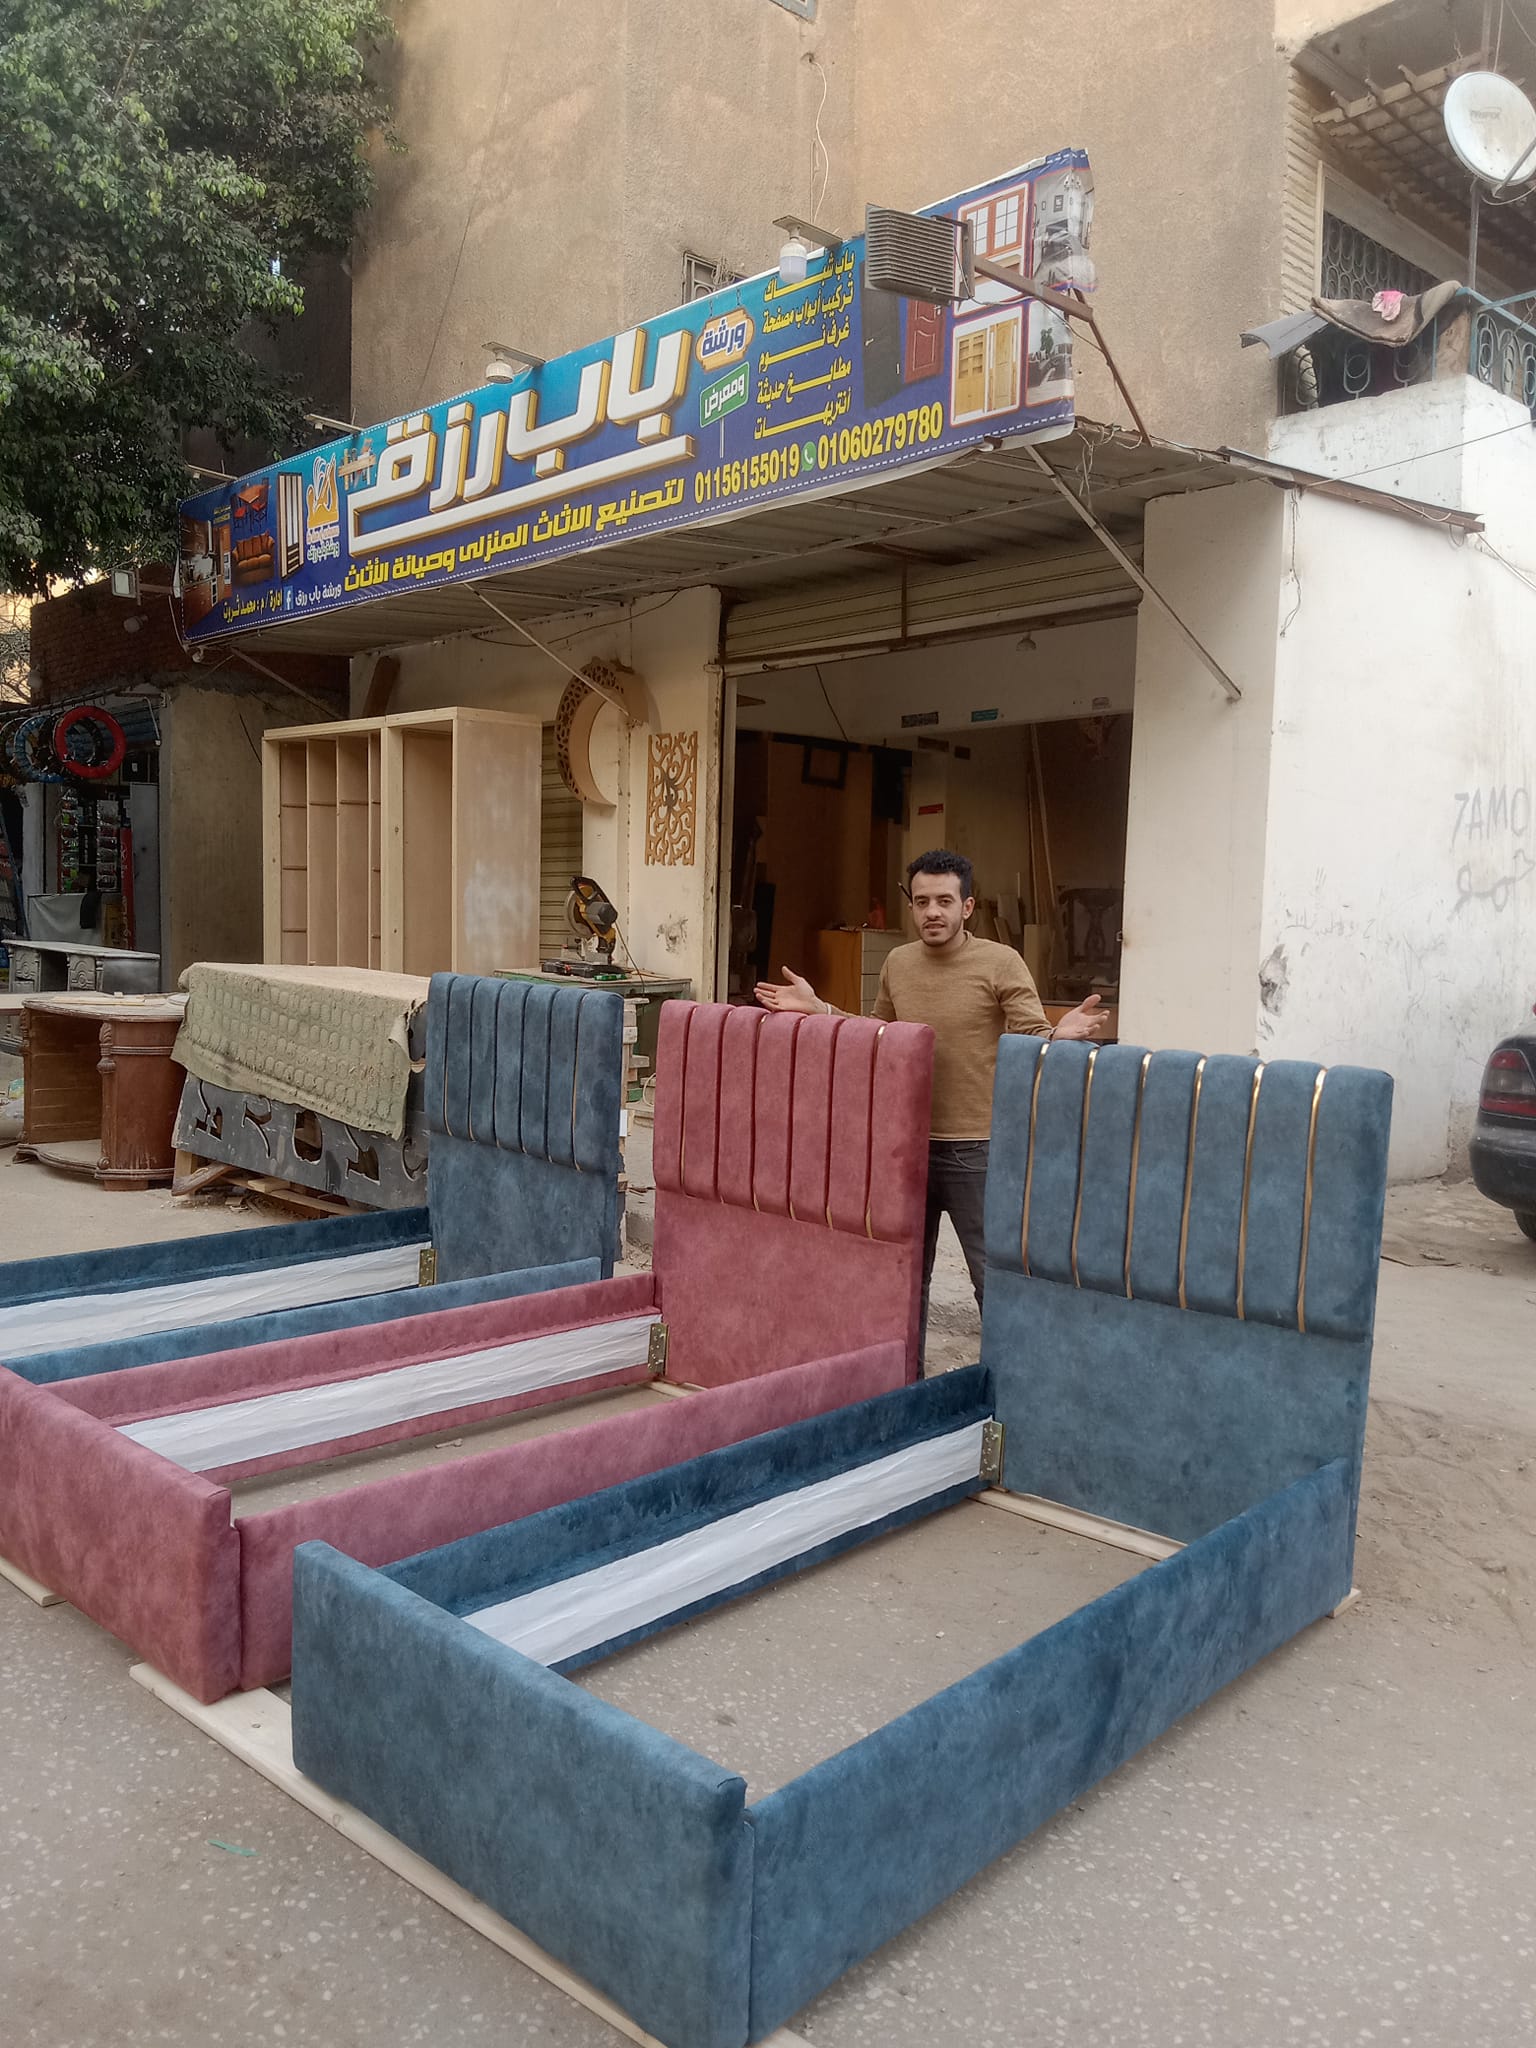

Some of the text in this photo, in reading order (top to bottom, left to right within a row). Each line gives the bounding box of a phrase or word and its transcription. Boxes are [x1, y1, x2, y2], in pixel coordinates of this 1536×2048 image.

[834, 248, 855, 278] باب
[762, 279, 855, 335] تركيب أبواب مصفحة
[701, 316, 748, 359] ورشة
[758, 315, 850, 374] غرف نوم
[506, 327, 694, 478] باب
[703, 372, 745, 420] ومعرض
[756, 355, 852, 410] مطابخ حديثة
[694, 401, 943, 504] 01156155019 01060279780
[532, 503, 593, 543] الاثاث
[595, 478, 685, 532] لتصنيع
[344, 557, 390, 592] الأثاث
[392, 548, 456, 580] وصيانة
[295, 582, 342, 606] ورشة باب رزق
